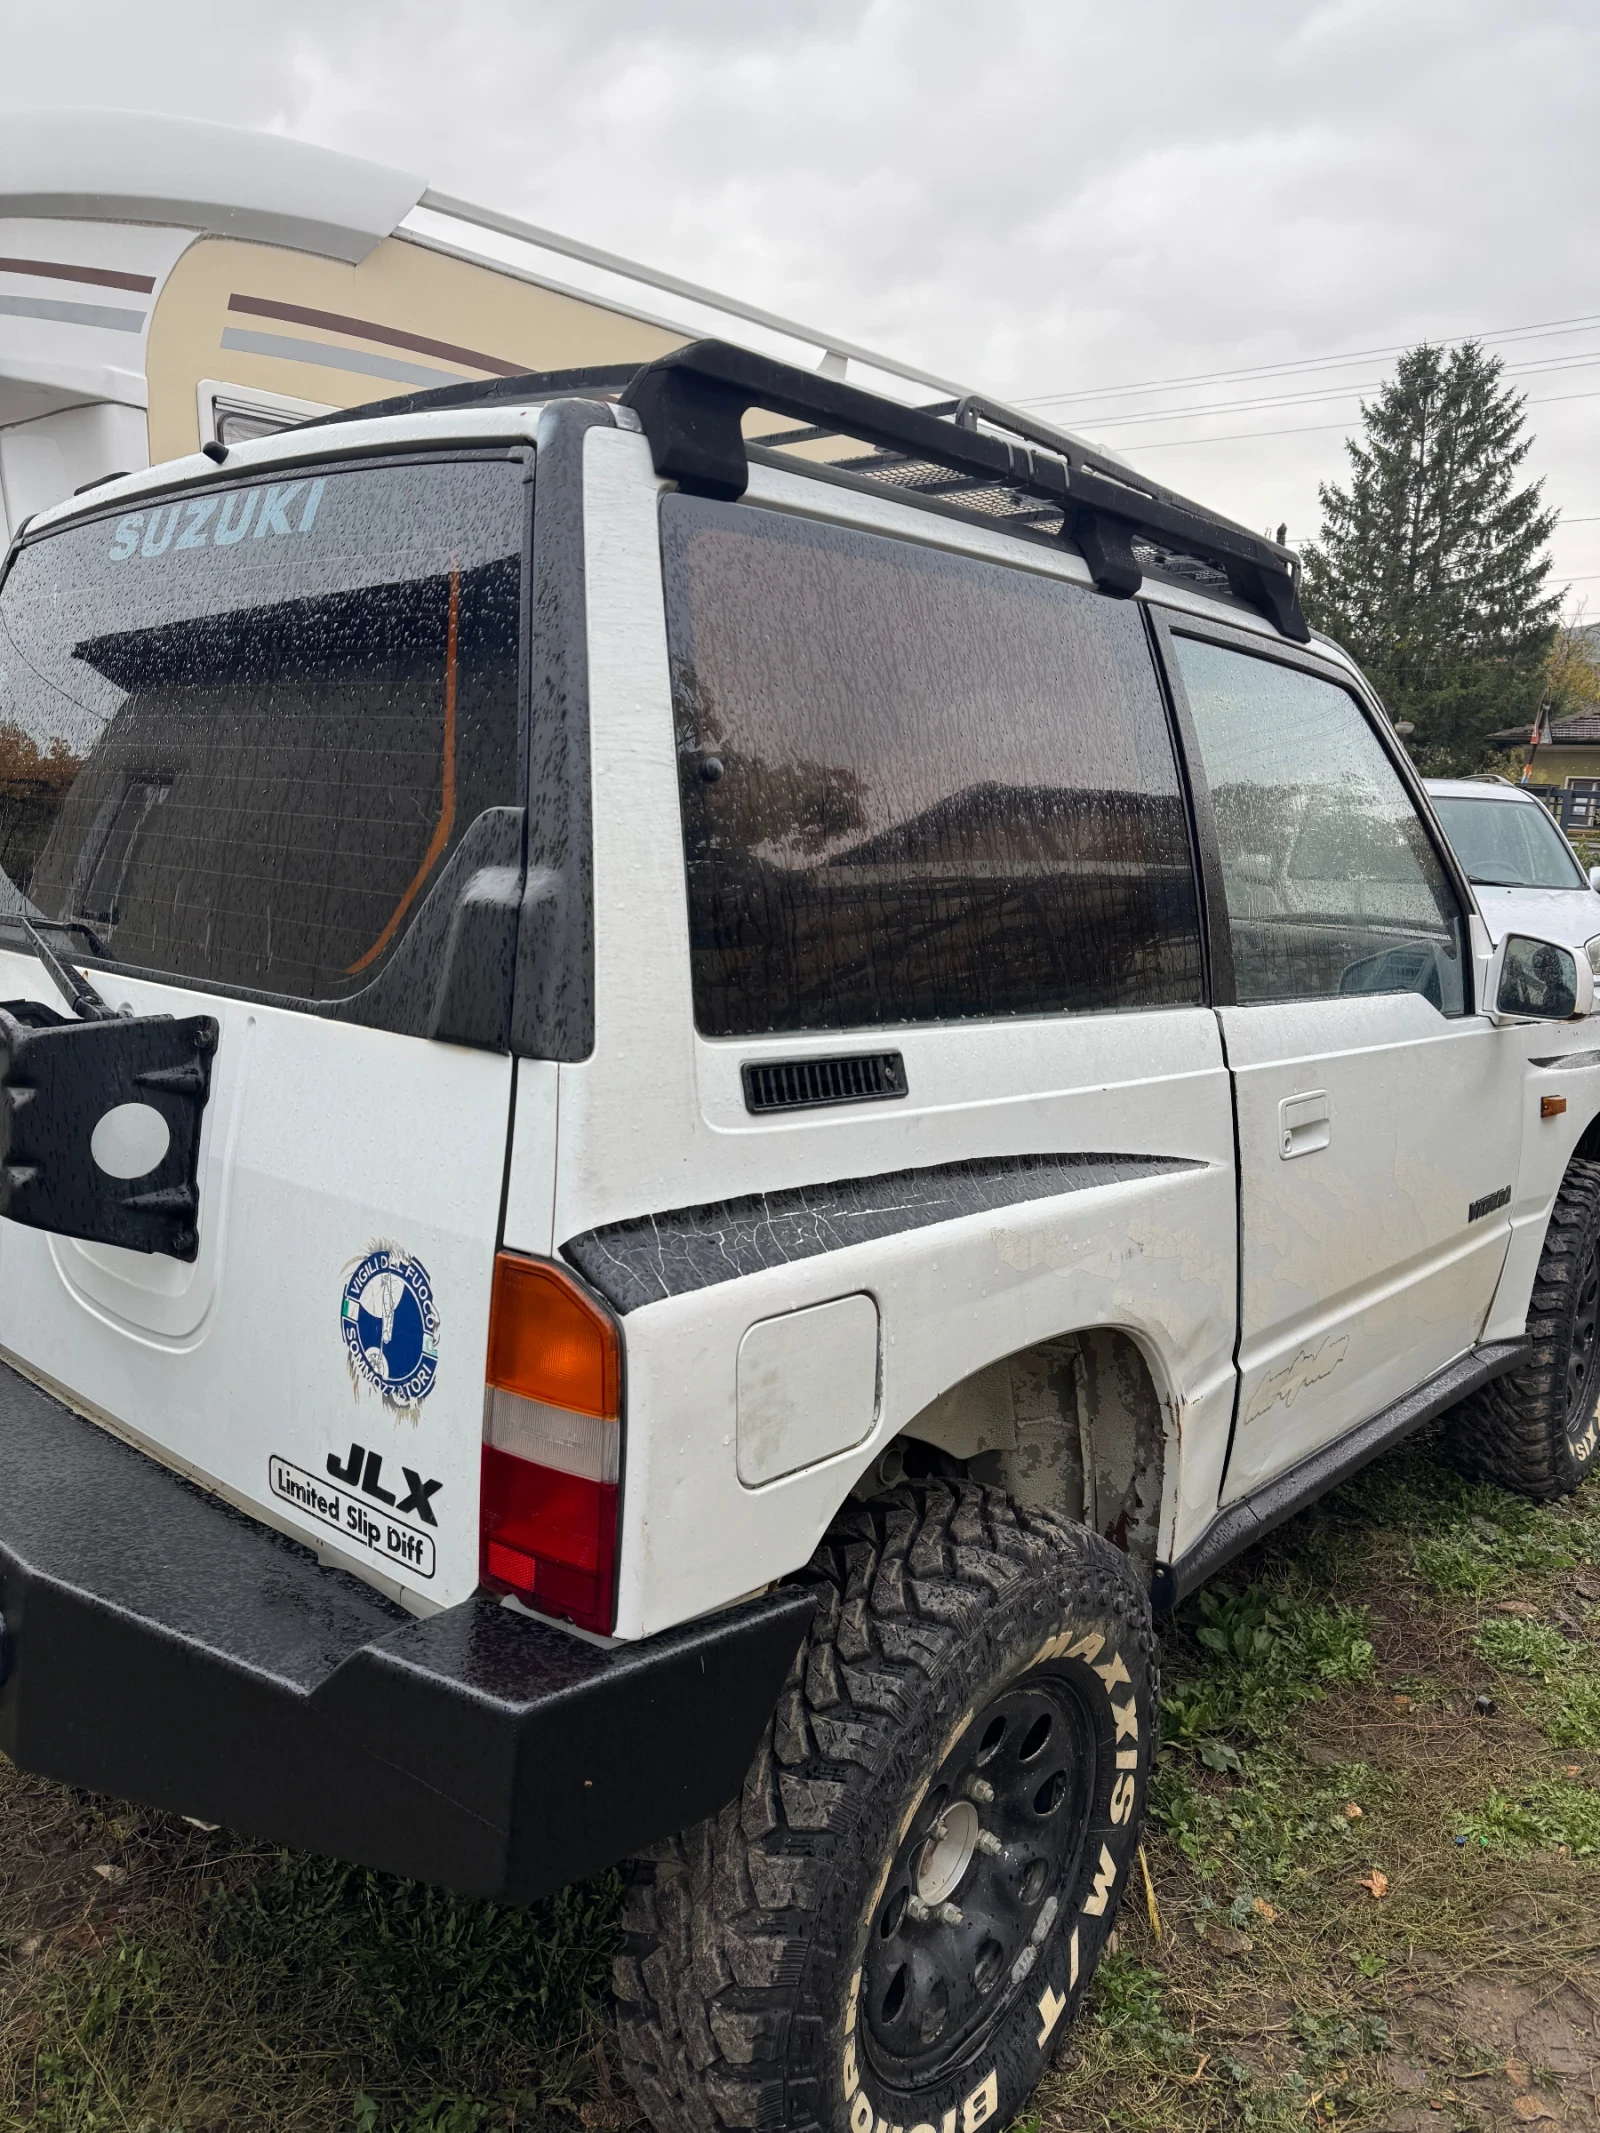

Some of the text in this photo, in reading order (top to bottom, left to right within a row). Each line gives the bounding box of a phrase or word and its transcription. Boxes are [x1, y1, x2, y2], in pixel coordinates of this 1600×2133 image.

[108, 479, 328, 561] SUZUKI
[350, 1256, 379, 1294] VIGILI
[405, 1266, 436, 1329] FUOCO
[278, 1467, 423, 1565] Limited Slip Diff
[326, 1443, 443, 1527] JLX
[1016, 1631, 1138, 1826] MAXXIS
